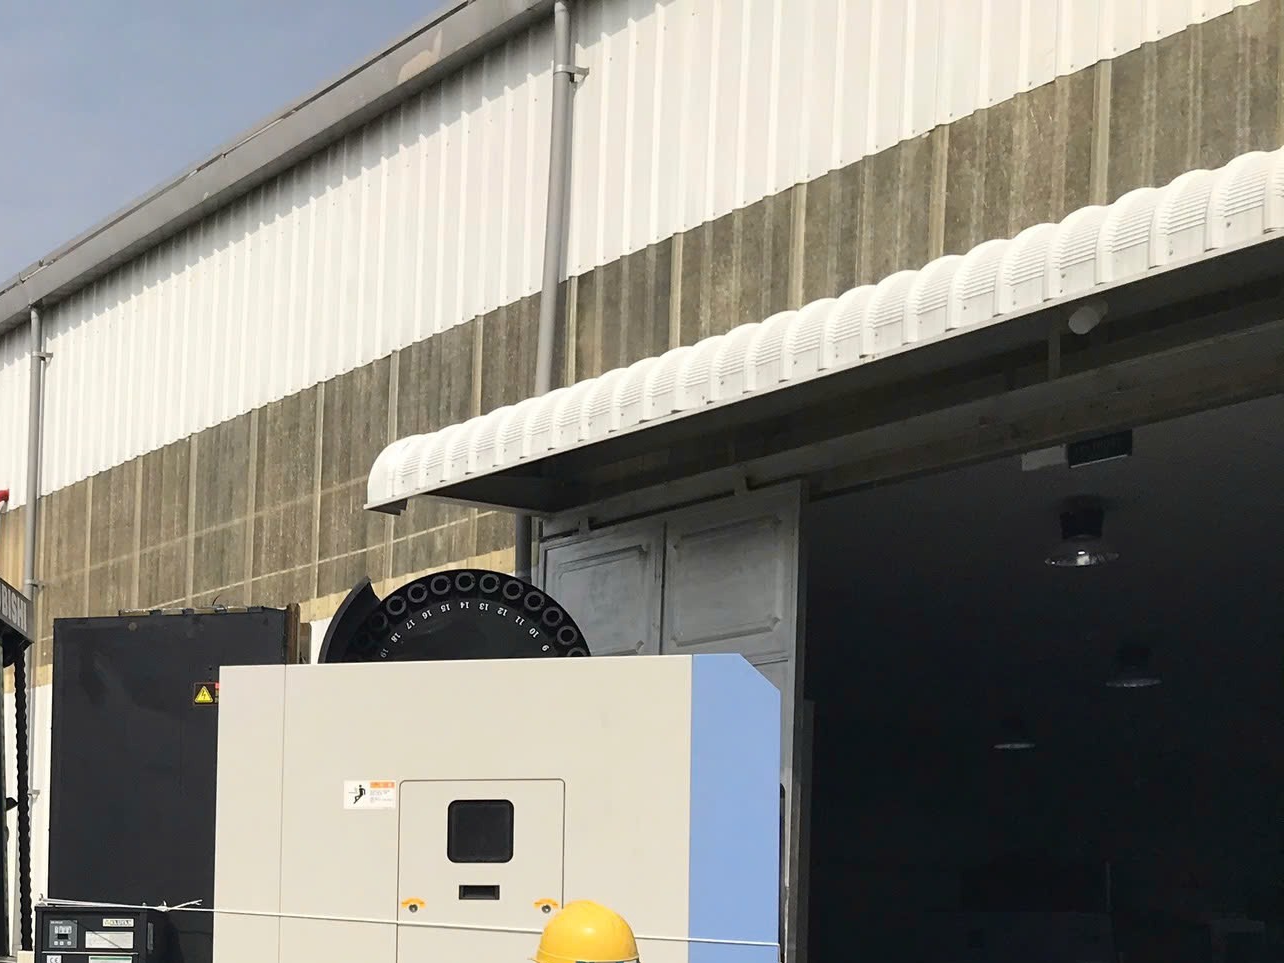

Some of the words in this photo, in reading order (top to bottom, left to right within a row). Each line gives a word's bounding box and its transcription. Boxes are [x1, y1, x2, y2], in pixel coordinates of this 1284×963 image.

[440, 603, 451, 613] 15
[460, 601, 470, 609] 14
[479, 602, 489, 611] 13
[421, 609, 433, 620] 16
[497, 607, 508, 617] 12
[406, 619, 416, 630] 17
[515, 615, 525, 626] 11
[390, 632, 401, 643] 18
[529, 627, 540, 638] 10
[380, 648, 389, 658] 19
